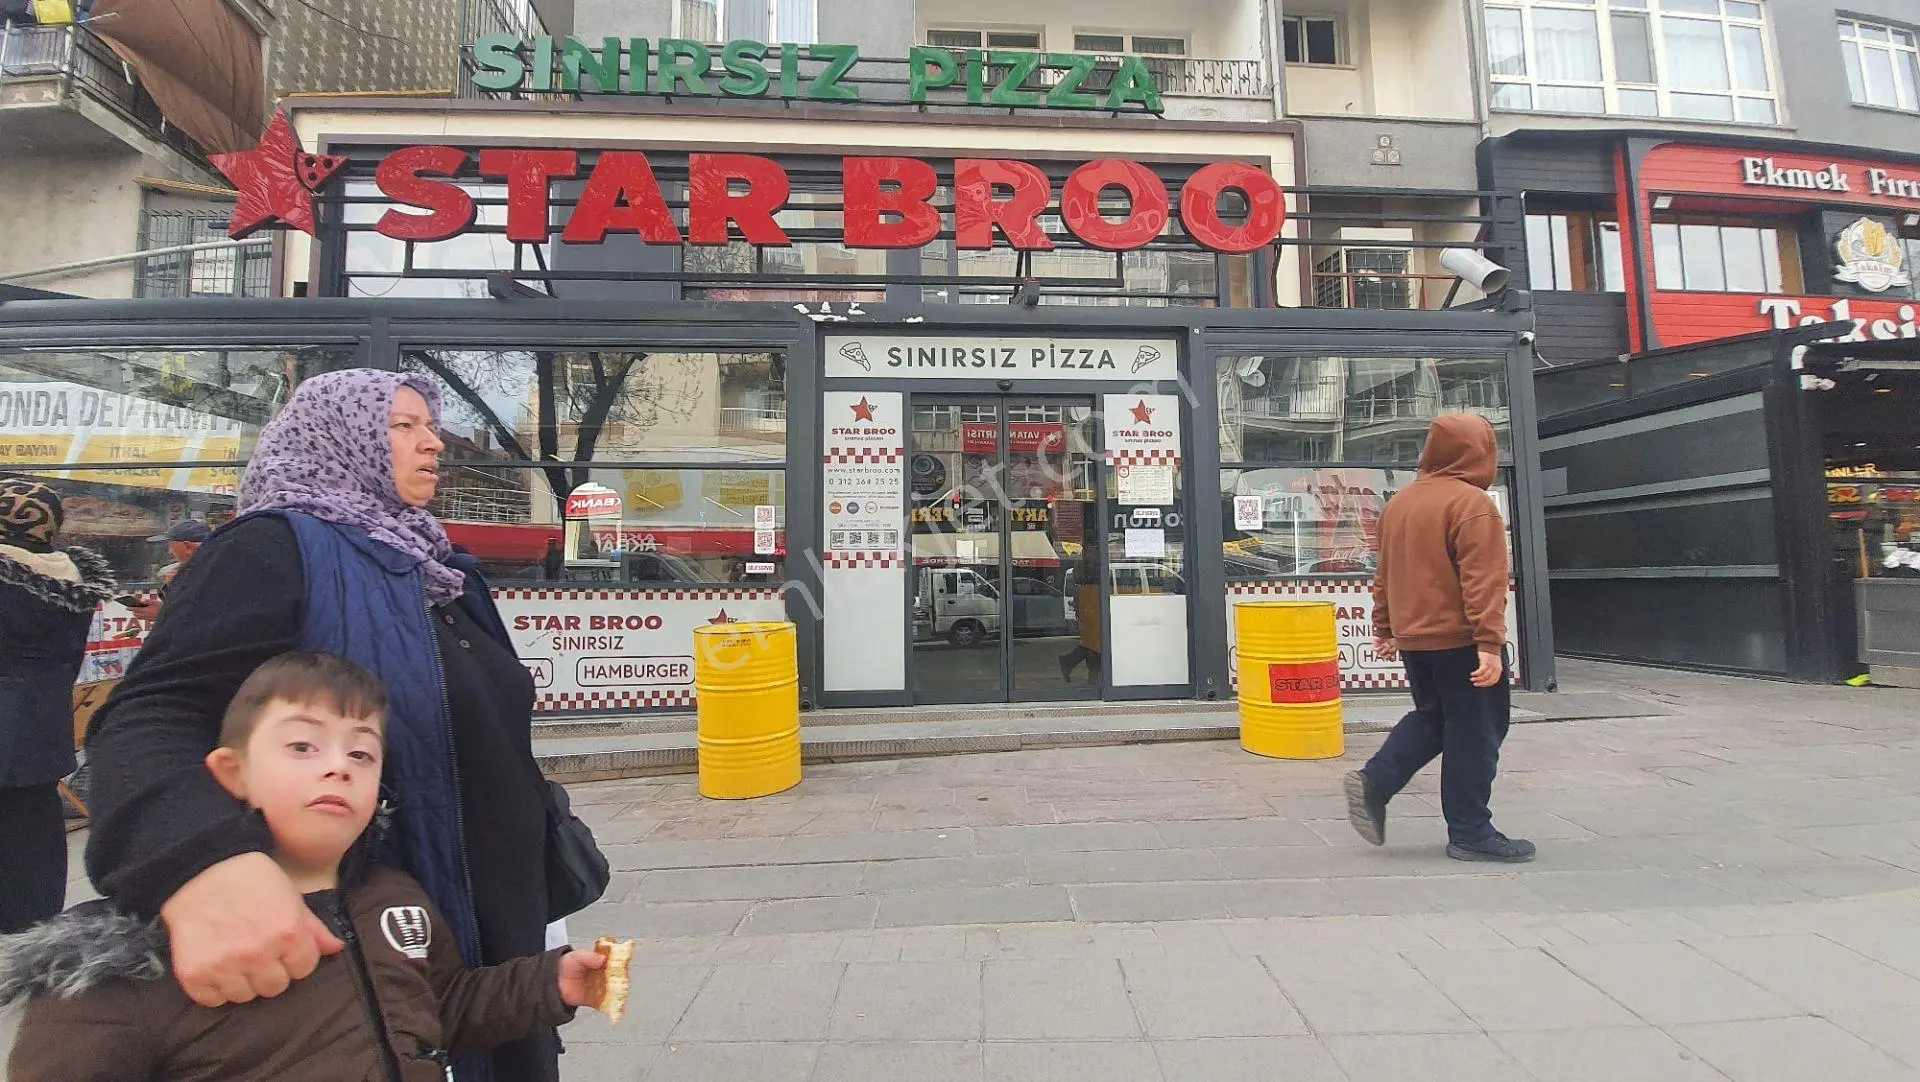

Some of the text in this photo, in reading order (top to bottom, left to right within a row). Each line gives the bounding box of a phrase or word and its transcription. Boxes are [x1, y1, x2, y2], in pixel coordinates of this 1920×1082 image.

[1743, 157, 1851, 192] Ekmek
[375, 145, 1287, 254] STAR BROO
[887, 343, 1116, 369] SINIRSIZ PİZZA
[1336, 607, 1365, 620] AR
[514, 615, 663, 630] STAR BROO
[552, 636, 624, 650] SINIRSIZ
[584, 664, 688, 679] HAMBURGER
[1275, 677, 1323, 691] STAR
